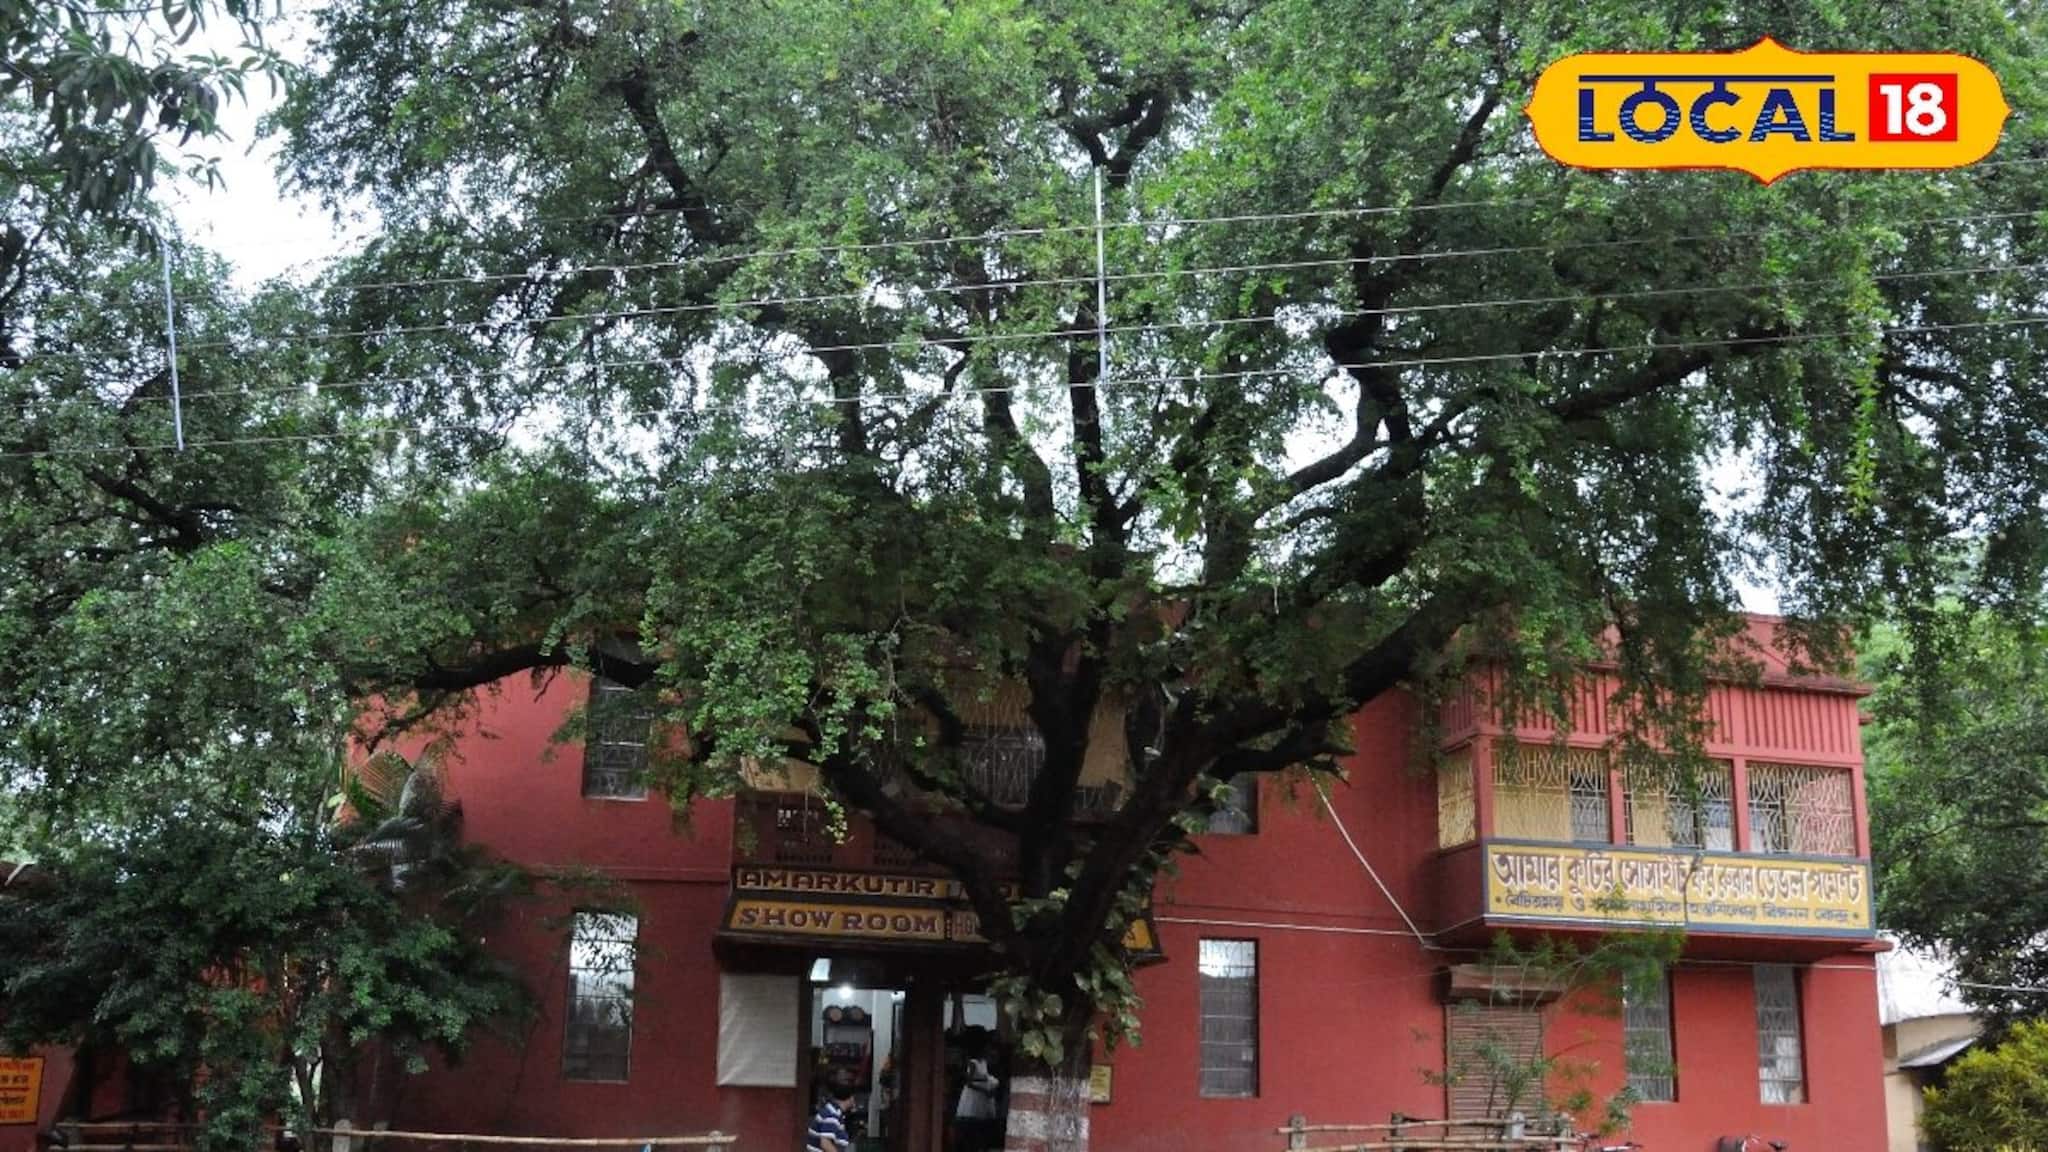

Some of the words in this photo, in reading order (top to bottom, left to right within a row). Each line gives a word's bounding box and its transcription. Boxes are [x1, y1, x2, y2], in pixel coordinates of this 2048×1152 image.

[1491, 851, 1564, 893] আমার
[1567, 848, 1617, 896] কুটির
[740, 907, 835, 929] SHOW
[841, 911, 937, 933] ROOM
